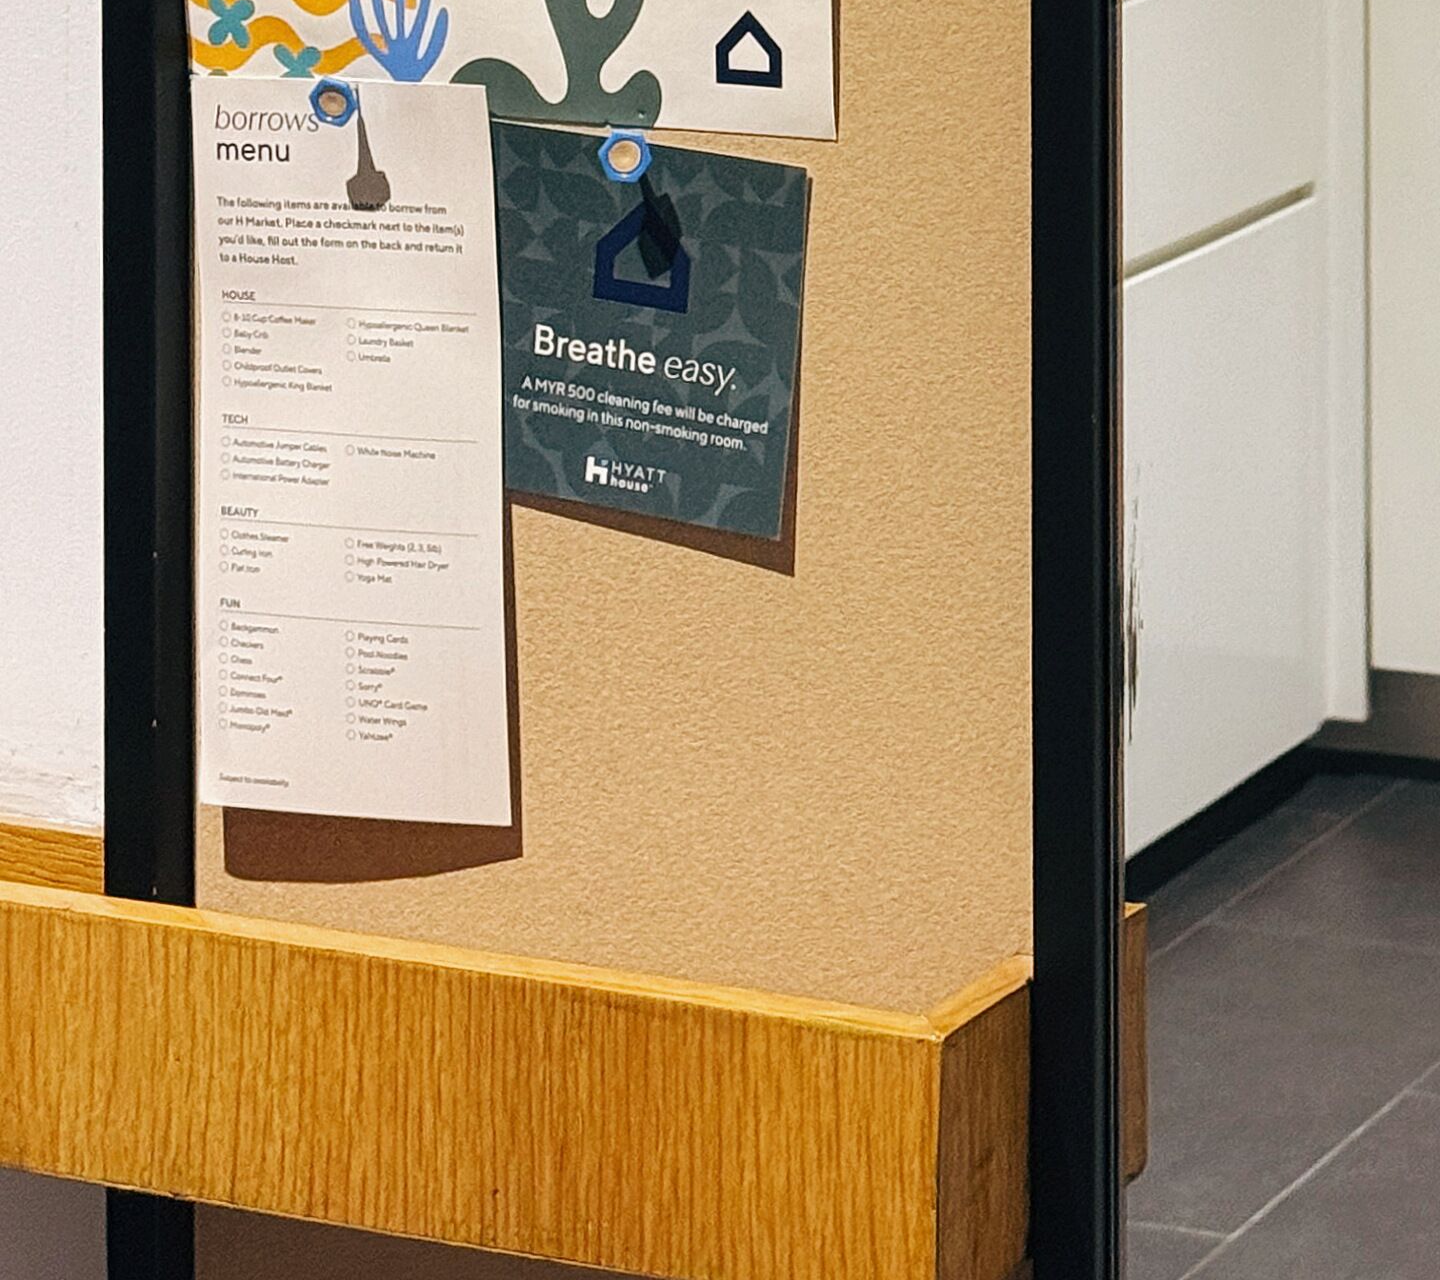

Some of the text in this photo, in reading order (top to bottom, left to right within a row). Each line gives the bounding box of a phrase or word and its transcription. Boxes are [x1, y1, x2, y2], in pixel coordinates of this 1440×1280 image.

[215, 104, 319, 132] borrows
[216, 142, 290, 162] menu
[221, 289, 256, 301] HOUSE
[534, 324, 736, 395] Breathe easy.
[521, 375, 769, 434] A MYR 500 cleaning fee will be charged
[221, 413, 248, 424] TECH
[512, 393, 747, 451] for smoking in this non-smoking room.
[611, 461, 666, 483] HYATT
[220, 505, 259, 517] BEAUTY
[219, 597, 241, 608] FUN
